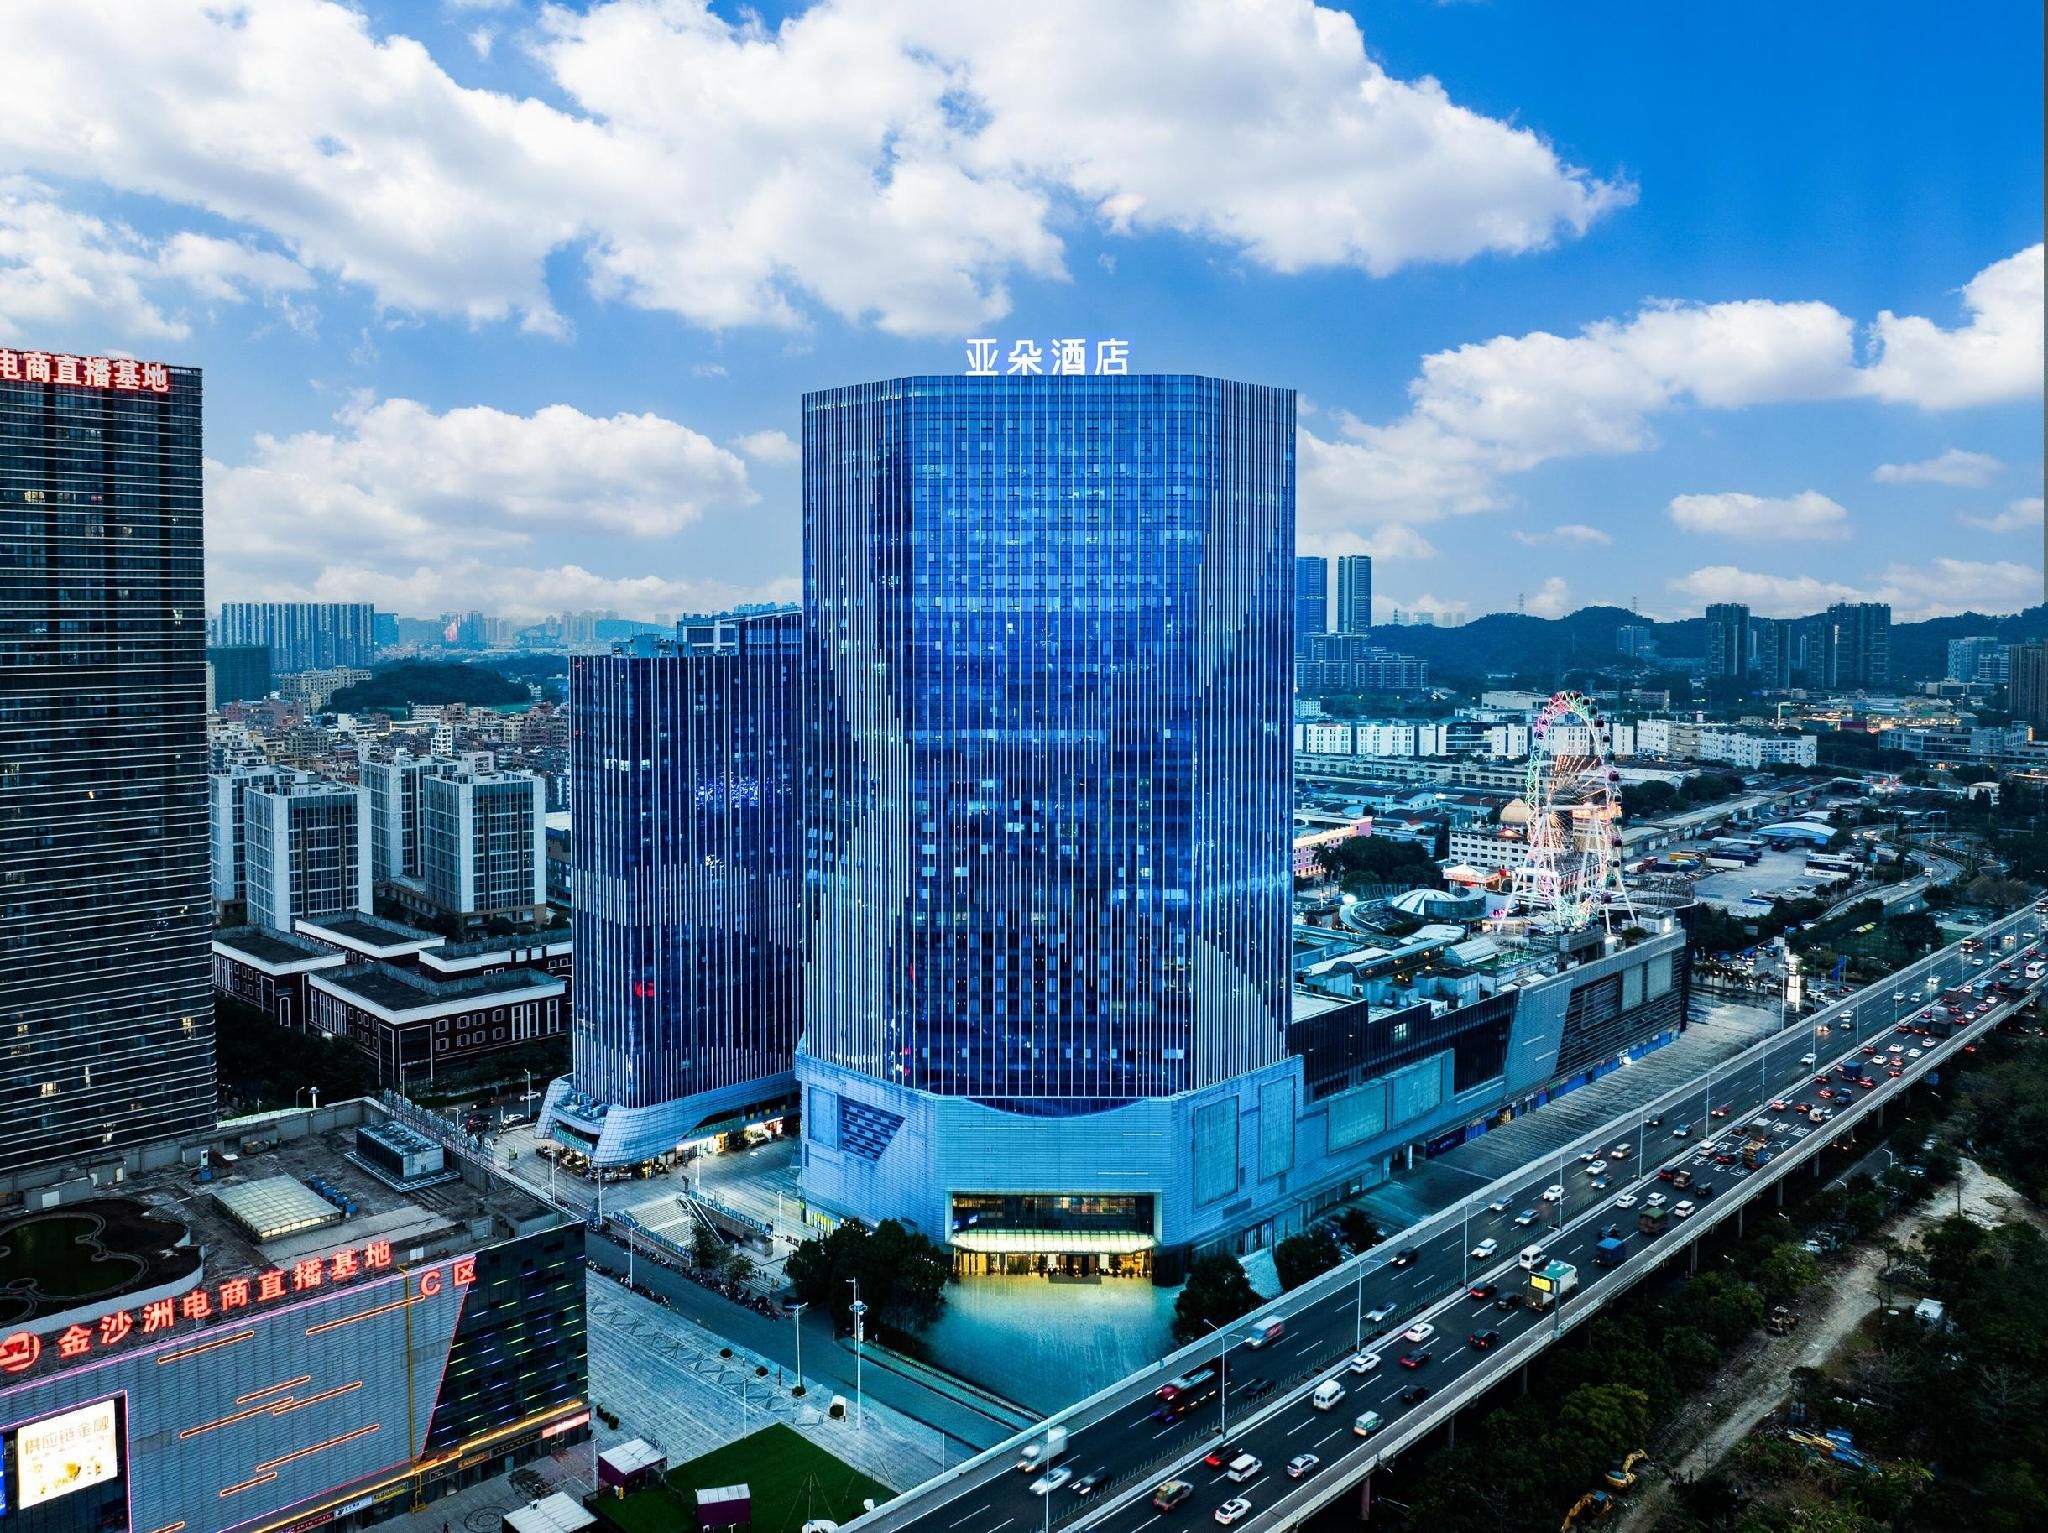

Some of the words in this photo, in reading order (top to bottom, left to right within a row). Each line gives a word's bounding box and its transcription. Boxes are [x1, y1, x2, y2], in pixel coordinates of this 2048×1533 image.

[0, 349, 169, 392] 电商直播基地
[965, 338, 1129, 376] 亚朵酒店
[57, 1239, 393, 1359] 金沙洲电商直播基地
